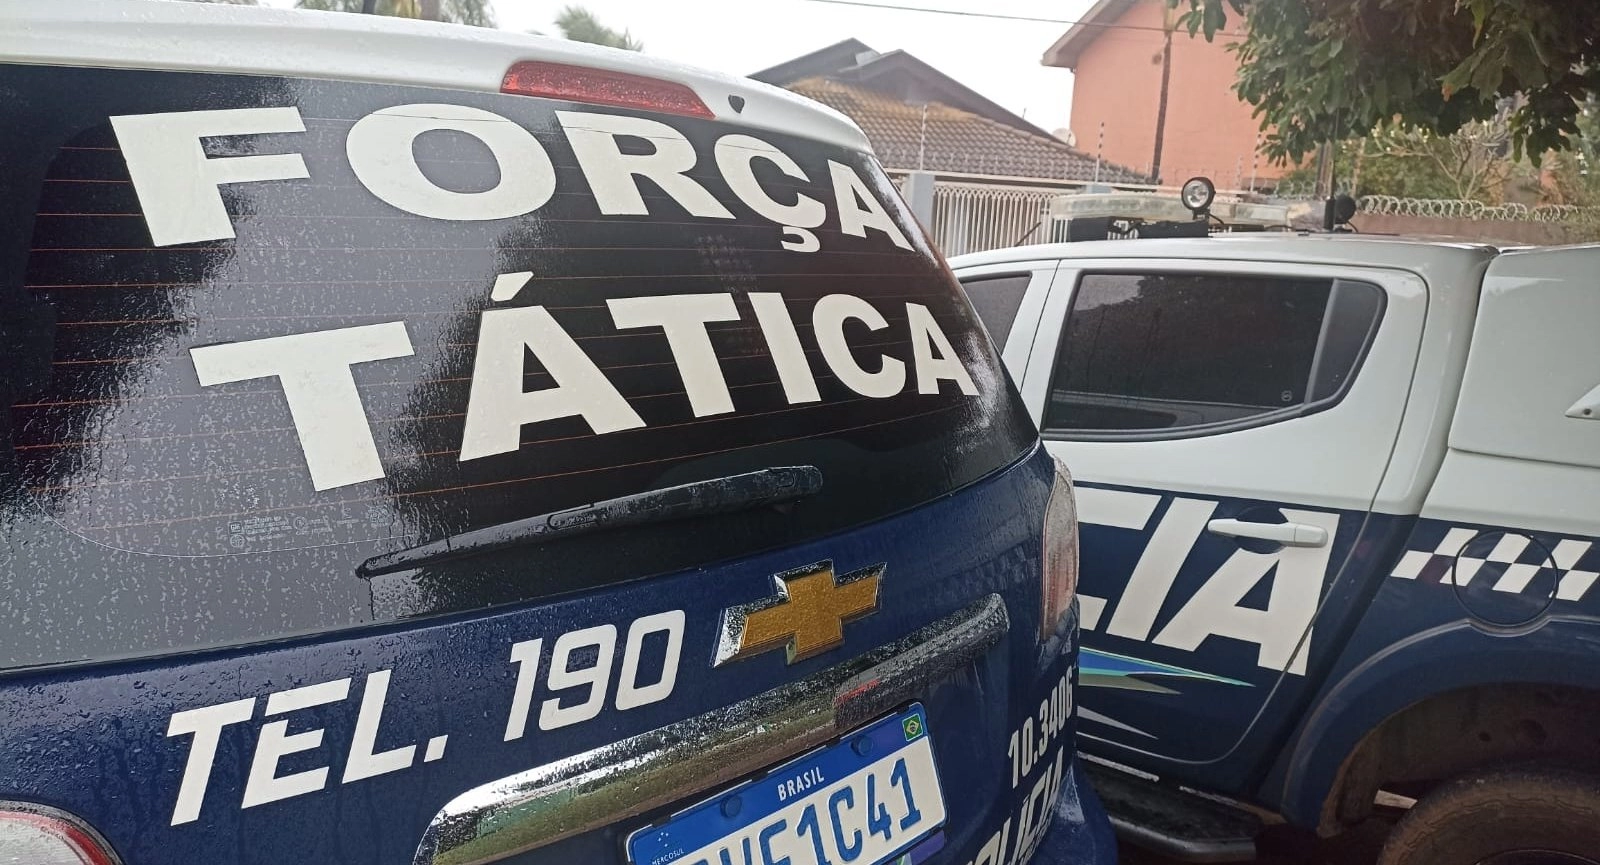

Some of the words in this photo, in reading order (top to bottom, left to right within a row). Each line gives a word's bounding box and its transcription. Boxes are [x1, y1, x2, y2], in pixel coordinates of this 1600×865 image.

[109, 103, 915, 252] FORÇA
[189, 271, 980, 492] TÁTICA
[166, 669, 449, 826] TEL.
[504, 609, 686, 741] 190
[690, 757, 922, 865] 1C41
[777, 766, 825, 802] BRASIL
[966, 745, 1064, 865] LÍCIA
[651, 848, 685, 865] MERCOSUL
